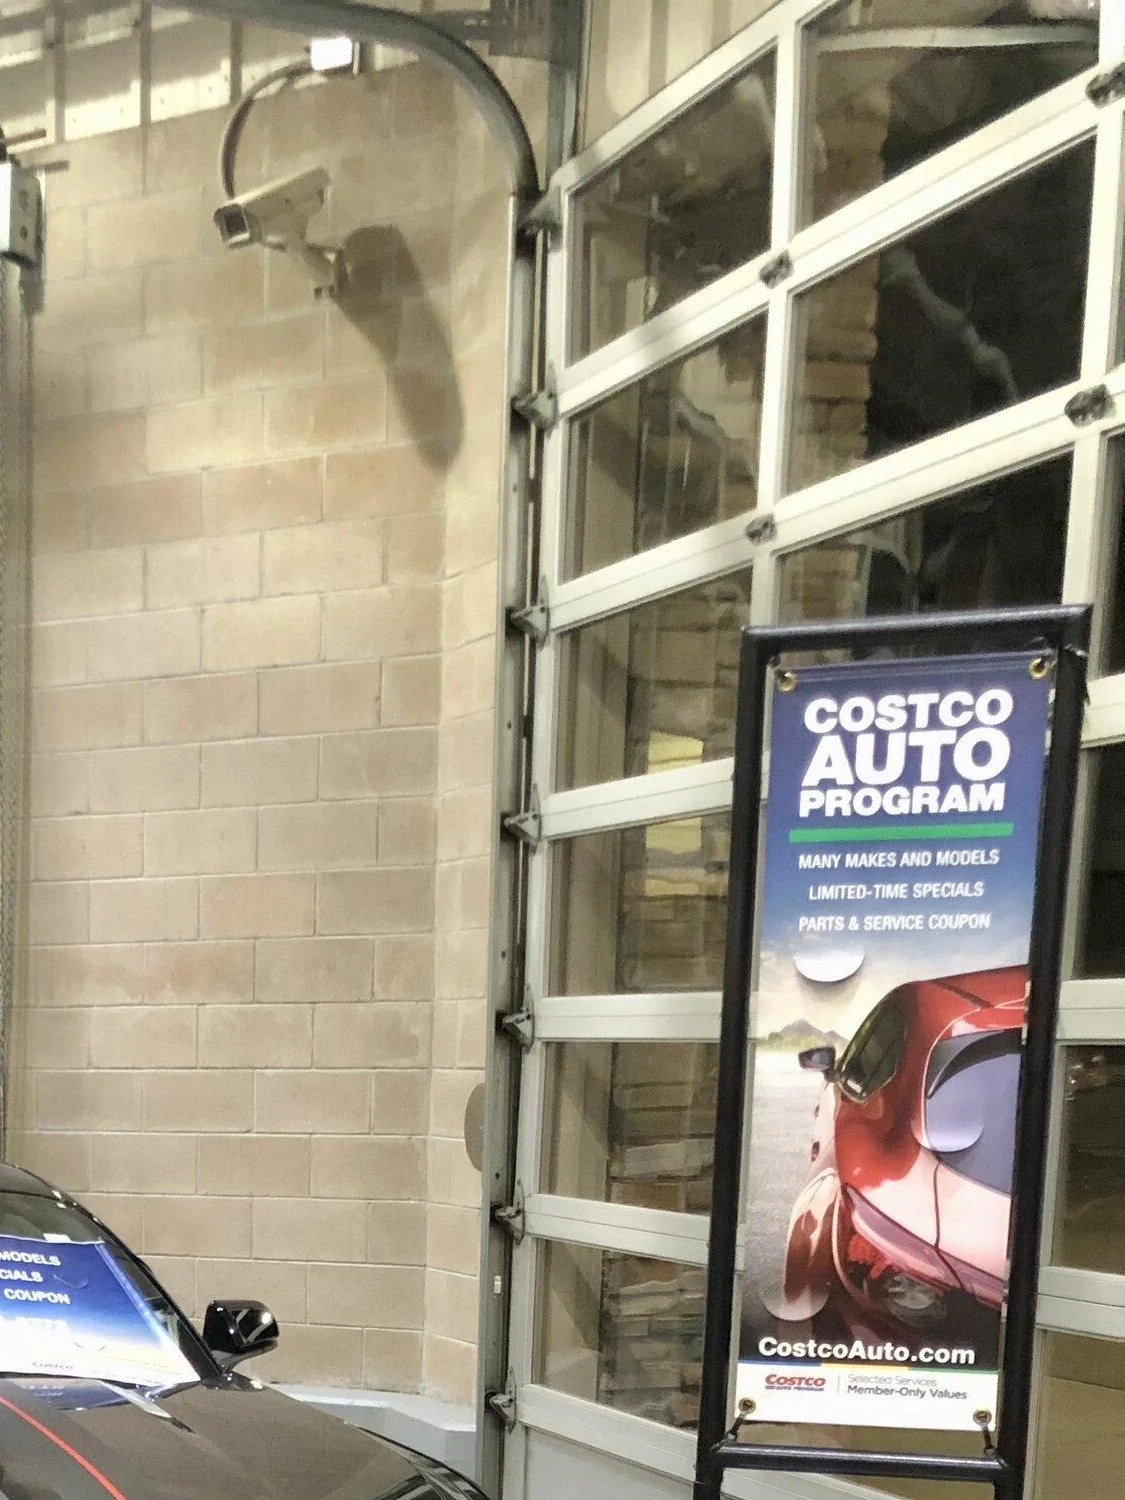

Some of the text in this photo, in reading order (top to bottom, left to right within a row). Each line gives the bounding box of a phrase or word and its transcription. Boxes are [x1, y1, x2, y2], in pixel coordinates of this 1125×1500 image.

[804, 688, 1013, 734] COSTCO
[801, 727, 1011, 787] AUTO
[799, 783, 1006, 817] PROGRAM
[798, 848, 1000, 869] MANY MAKES AND MODELS
[809, 881, 985, 900] LIMITED-TIME SPECIALS
[798, 911, 991, 932] PARTS & SERVICE COUPON
[4, 1288, 71, 1305] COUPON
[758, 1336, 975, 1364] CostcoAuto.com
[847, 1373, 938, 1387] Selected Services
[847, 1385, 968, 1400] Member-Only Values
